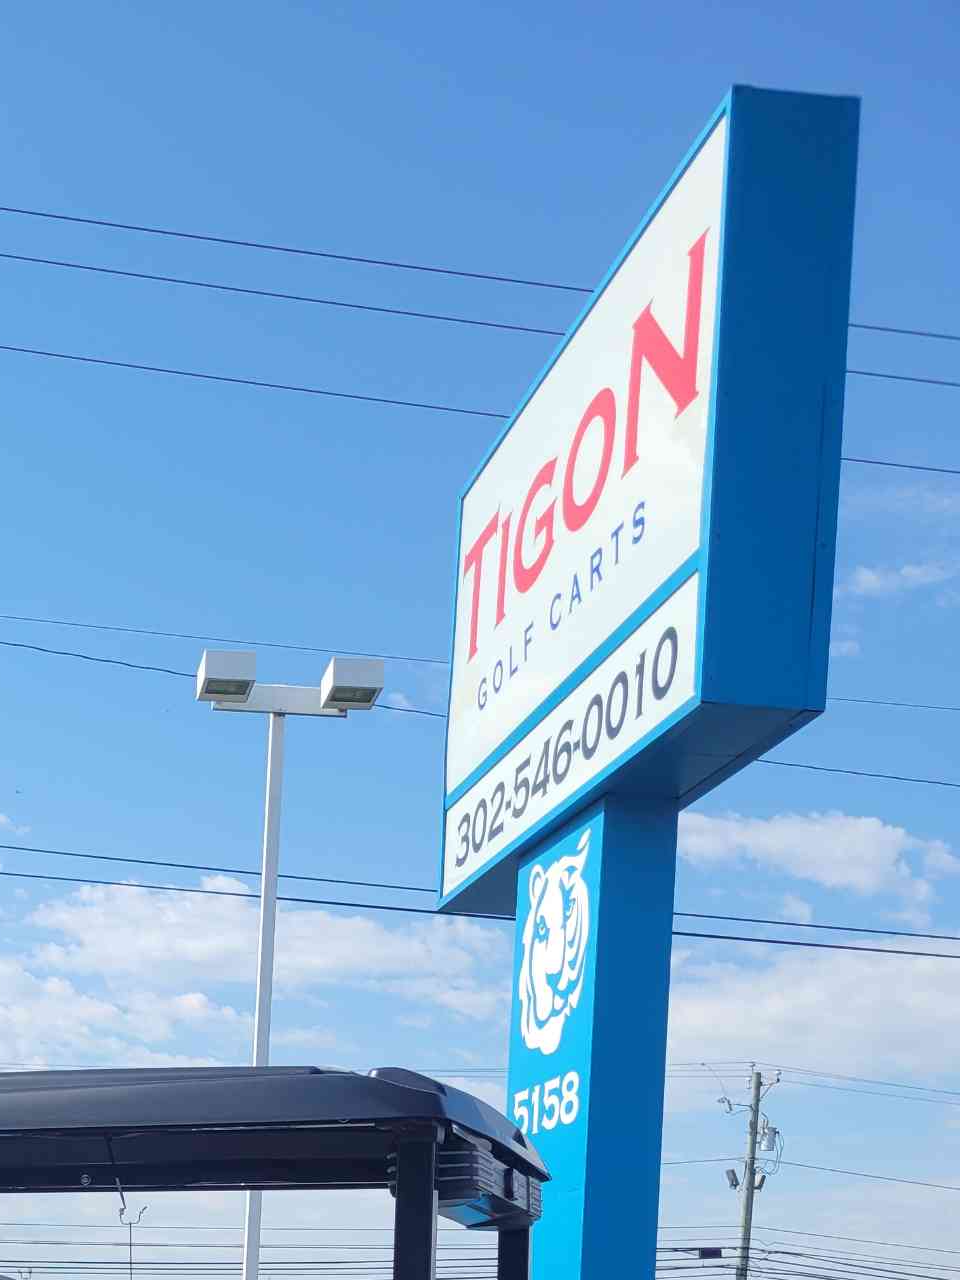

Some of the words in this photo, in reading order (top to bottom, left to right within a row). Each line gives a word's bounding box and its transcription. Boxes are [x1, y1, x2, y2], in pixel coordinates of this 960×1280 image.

[463, 226, 710, 664] TIGON
[477, 620, 534, 711] GOLF
[548, 500, 646, 631] CARTS
[454, 626, 679, 868] 302-546-0010
[513, 1071, 580, 1135] 5158
